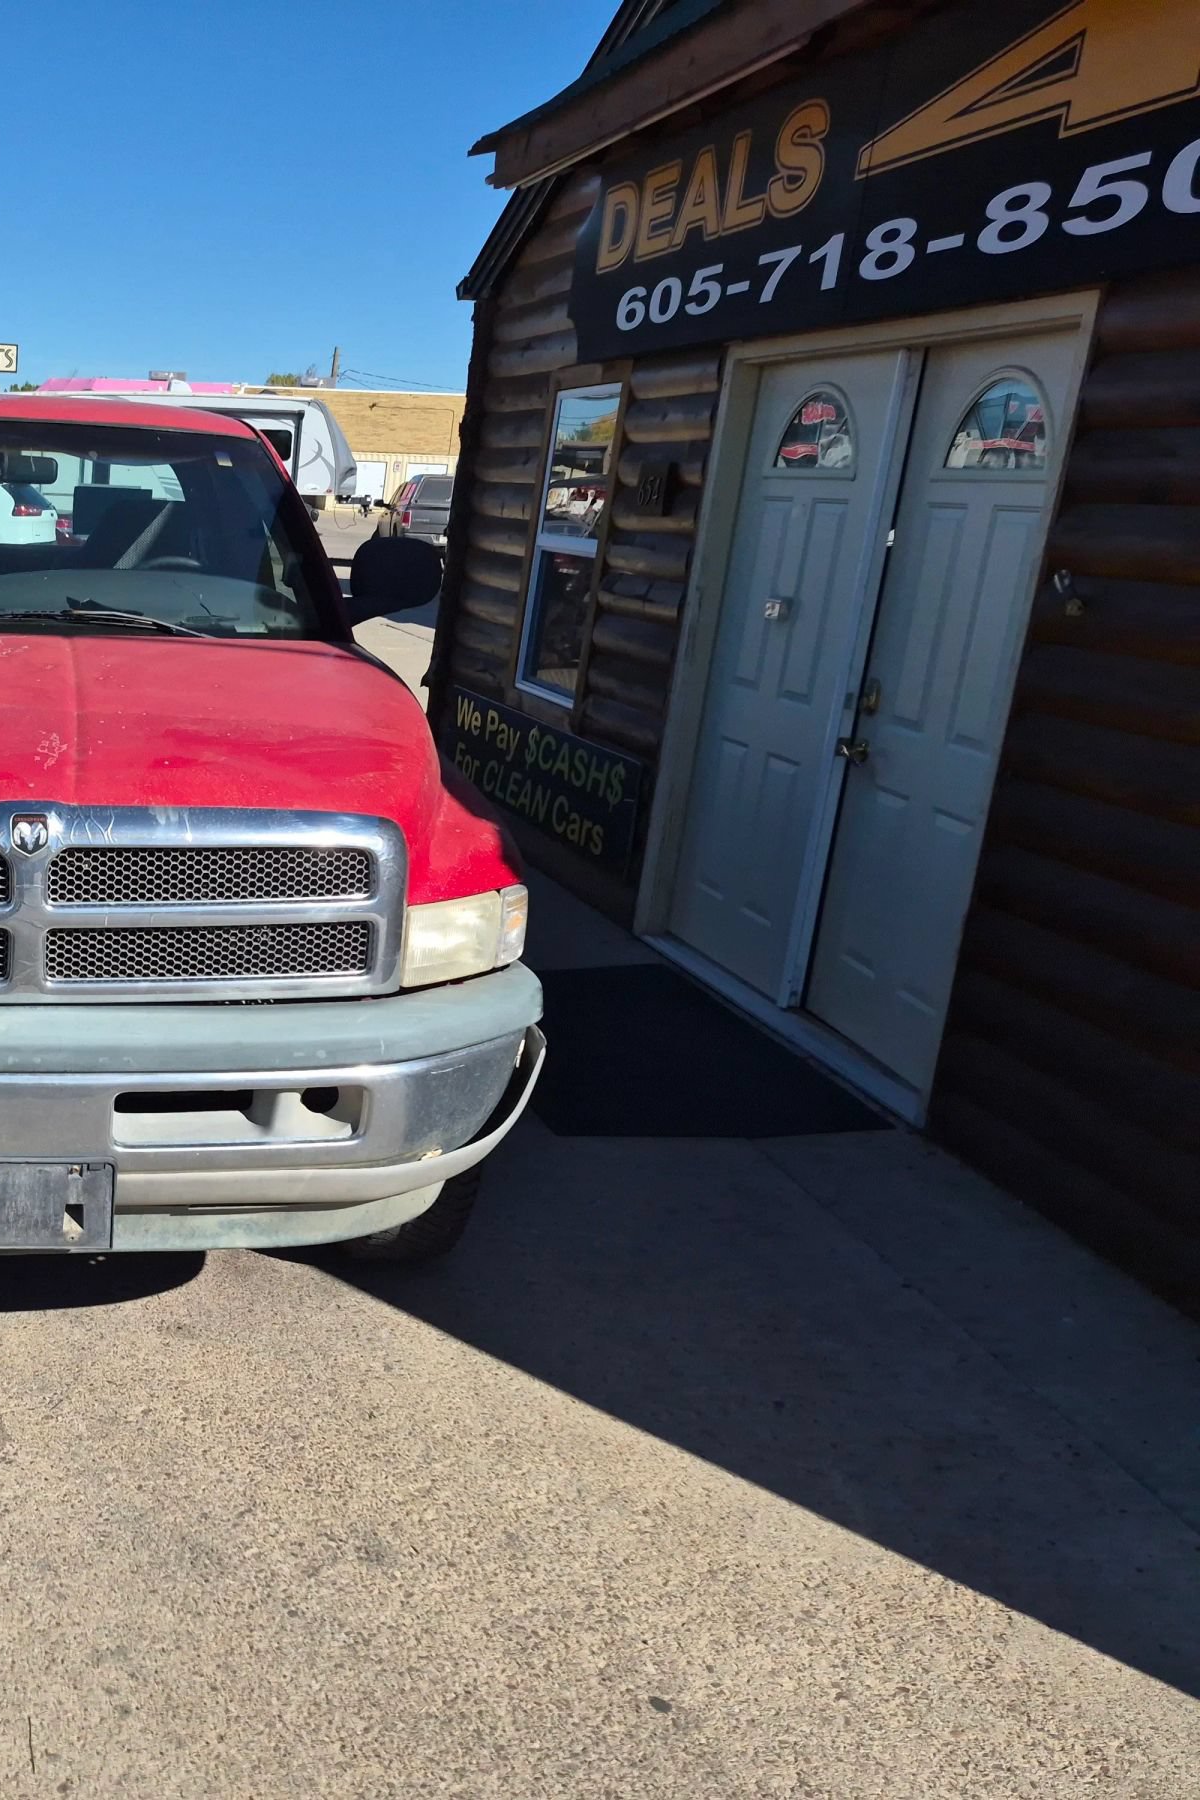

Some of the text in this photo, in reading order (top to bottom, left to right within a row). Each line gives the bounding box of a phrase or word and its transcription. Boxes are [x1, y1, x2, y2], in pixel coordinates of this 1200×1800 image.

[596, 99, 830, 274] DEALS
[455, 742, 604, 856] For CLEAN Cars
[457, 695, 627, 813] We Pay $CASH$
